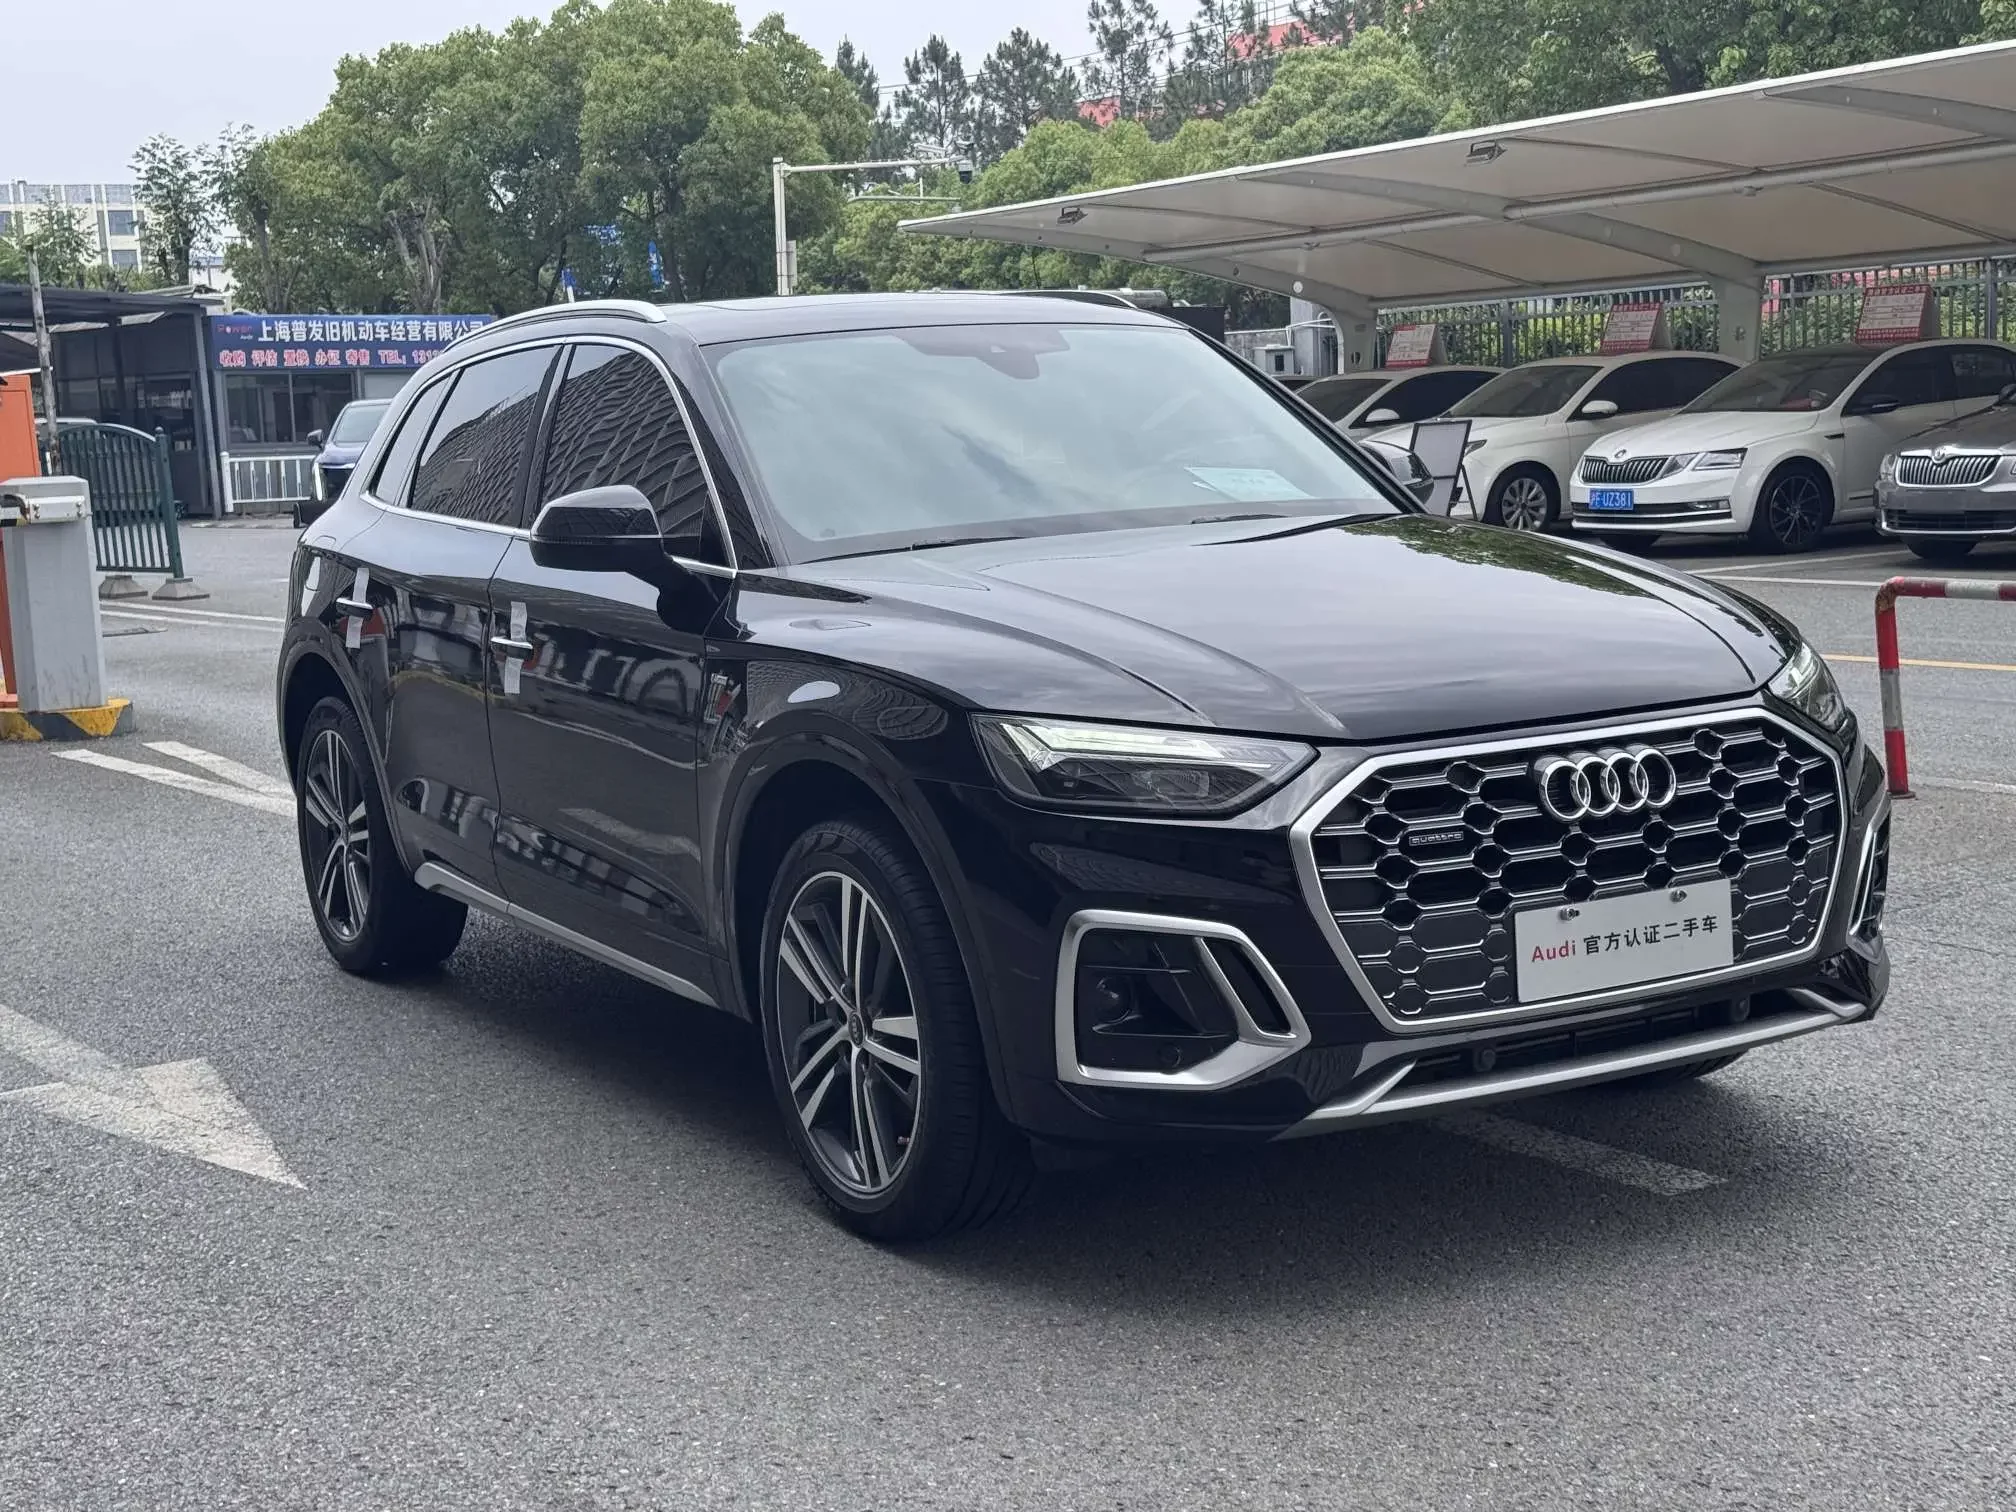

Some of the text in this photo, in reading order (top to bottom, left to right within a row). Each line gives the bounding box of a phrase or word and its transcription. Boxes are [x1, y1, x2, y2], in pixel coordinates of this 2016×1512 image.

[219, 349, 246, 367] 收购
[251, 349, 278, 367] 评估
[283, 349, 310, 367] 置换
[315, 348, 341, 366] 办证
[345, 348, 370, 366] 寄售
[1531, 915, 1718, 962] Audi 官方认证二手车
